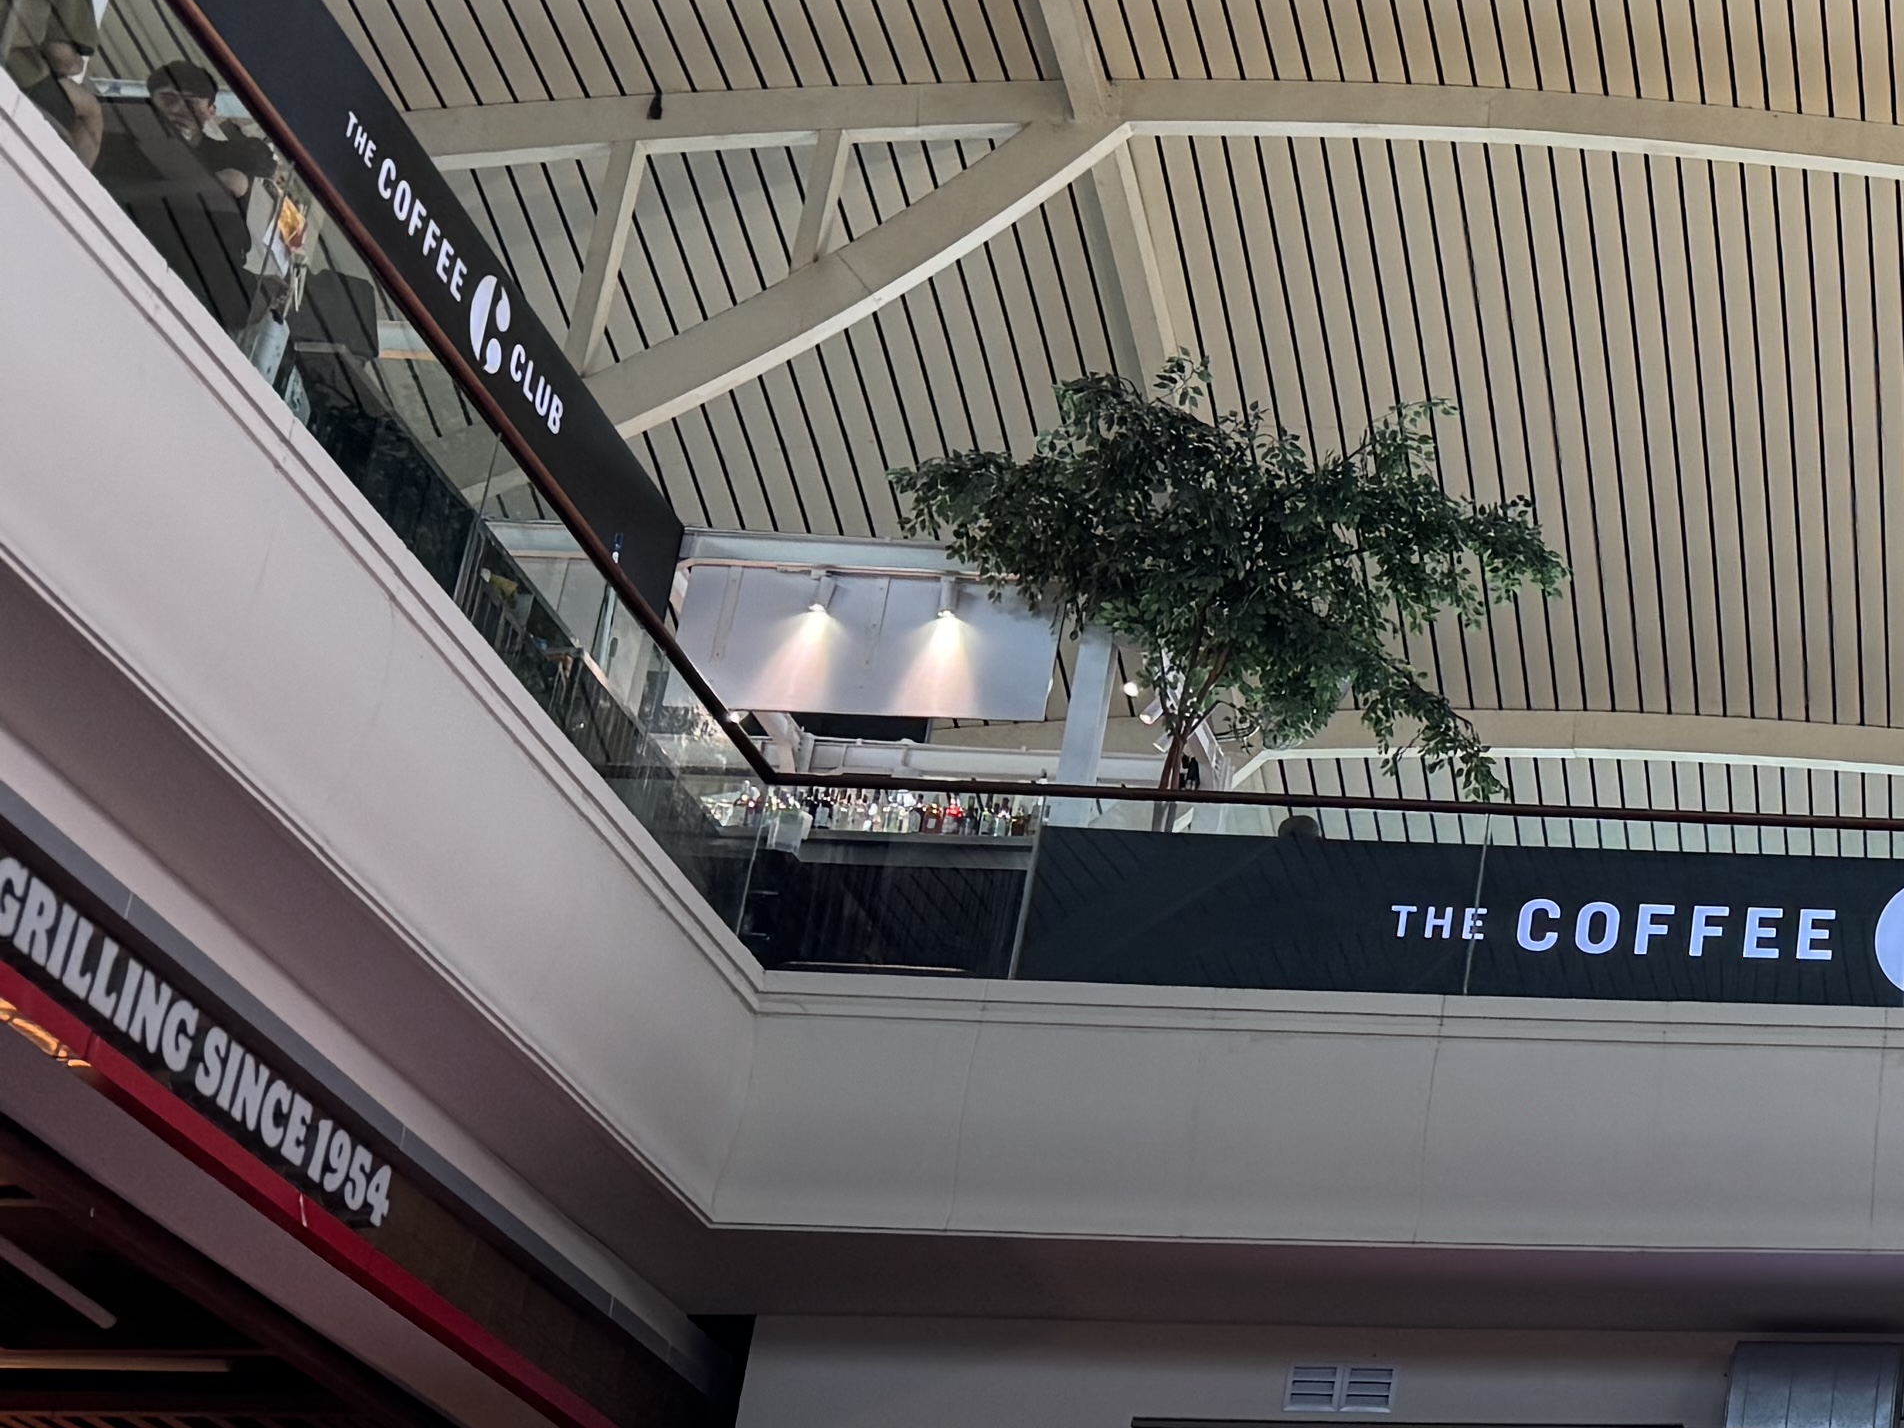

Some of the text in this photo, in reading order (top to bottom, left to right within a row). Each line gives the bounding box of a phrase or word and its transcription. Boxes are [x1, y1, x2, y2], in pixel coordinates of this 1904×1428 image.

[345, 111, 565, 435] THE COFFEE CLUB
[0, 857, 393, 1228] GRILLING SINCE 1954
[1391, 904, 1487, 941] THE
[1515, 897, 1838, 962] COFFEE
